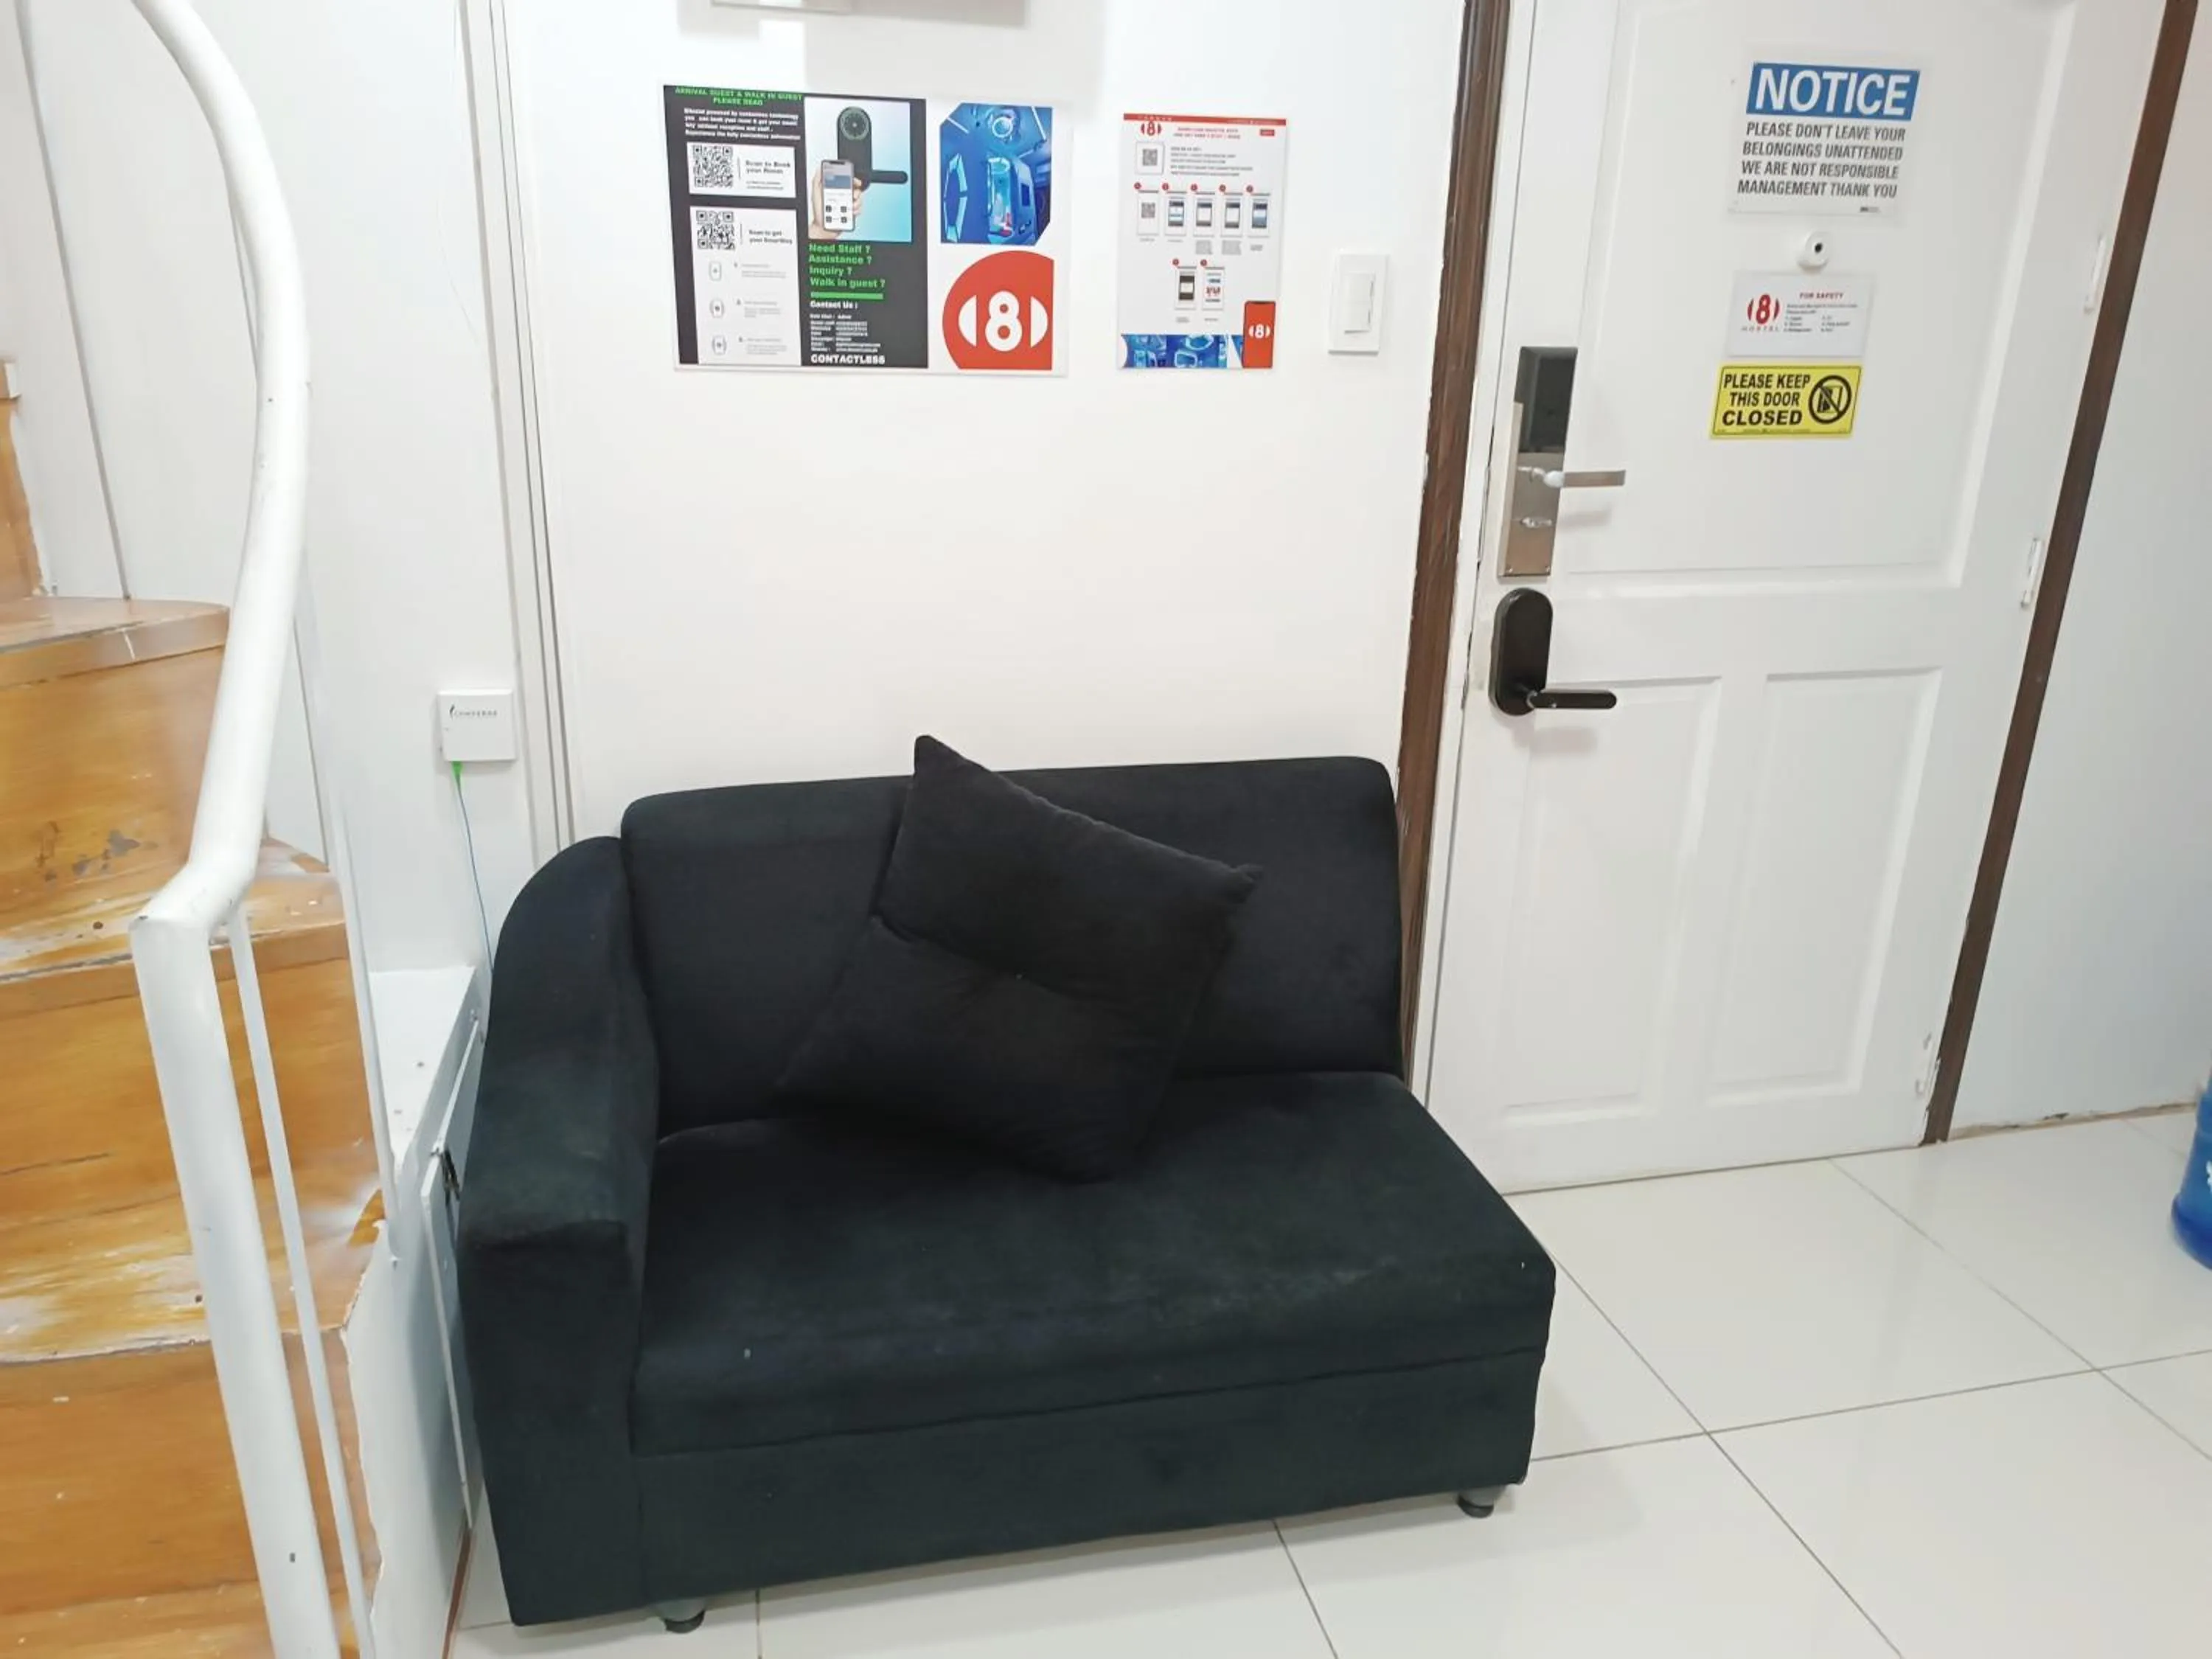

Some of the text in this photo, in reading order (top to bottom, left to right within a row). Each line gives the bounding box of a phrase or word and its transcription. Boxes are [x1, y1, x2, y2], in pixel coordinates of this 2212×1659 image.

[675, 87, 708, 95] ARRIVAL
[710, 89, 734, 97] GUEST
[777, 94, 803, 102] GUEST
[1755, 68, 1911, 116] NOTICE
[742, 98, 764, 106] READ
[1746, 121, 1906, 142] PLEASE DON'T LEAVE YOUR
[1742, 141, 1903, 161] BELONGINGS UNATTENDED
[1741, 160, 1899, 179] WE ARE NOT RESPONSIBLE
[1737, 179, 1898, 199] MANAGEMENT THANK YOU
[809, 243, 837, 253] Need
[838, 244, 863, 254] Staff
[809, 254, 864, 265] Assistance
[809, 265, 844, 276] Inquiry
[810, 276, 836, 288] Walk
[837, 278, 847, 288] in
[849, 279, 878, 290] guest
[810, 301, 841, 310] Contact
[843, 302, 853, 310] Us
[810, 354, 886, 365] CONTACTLESS
[1723, 373, 1811, 389] PLEASE KEEP
[1730, 391, 1801, 407] THIS DOOR
[1722, 409, 1803, 426] CLOSED
